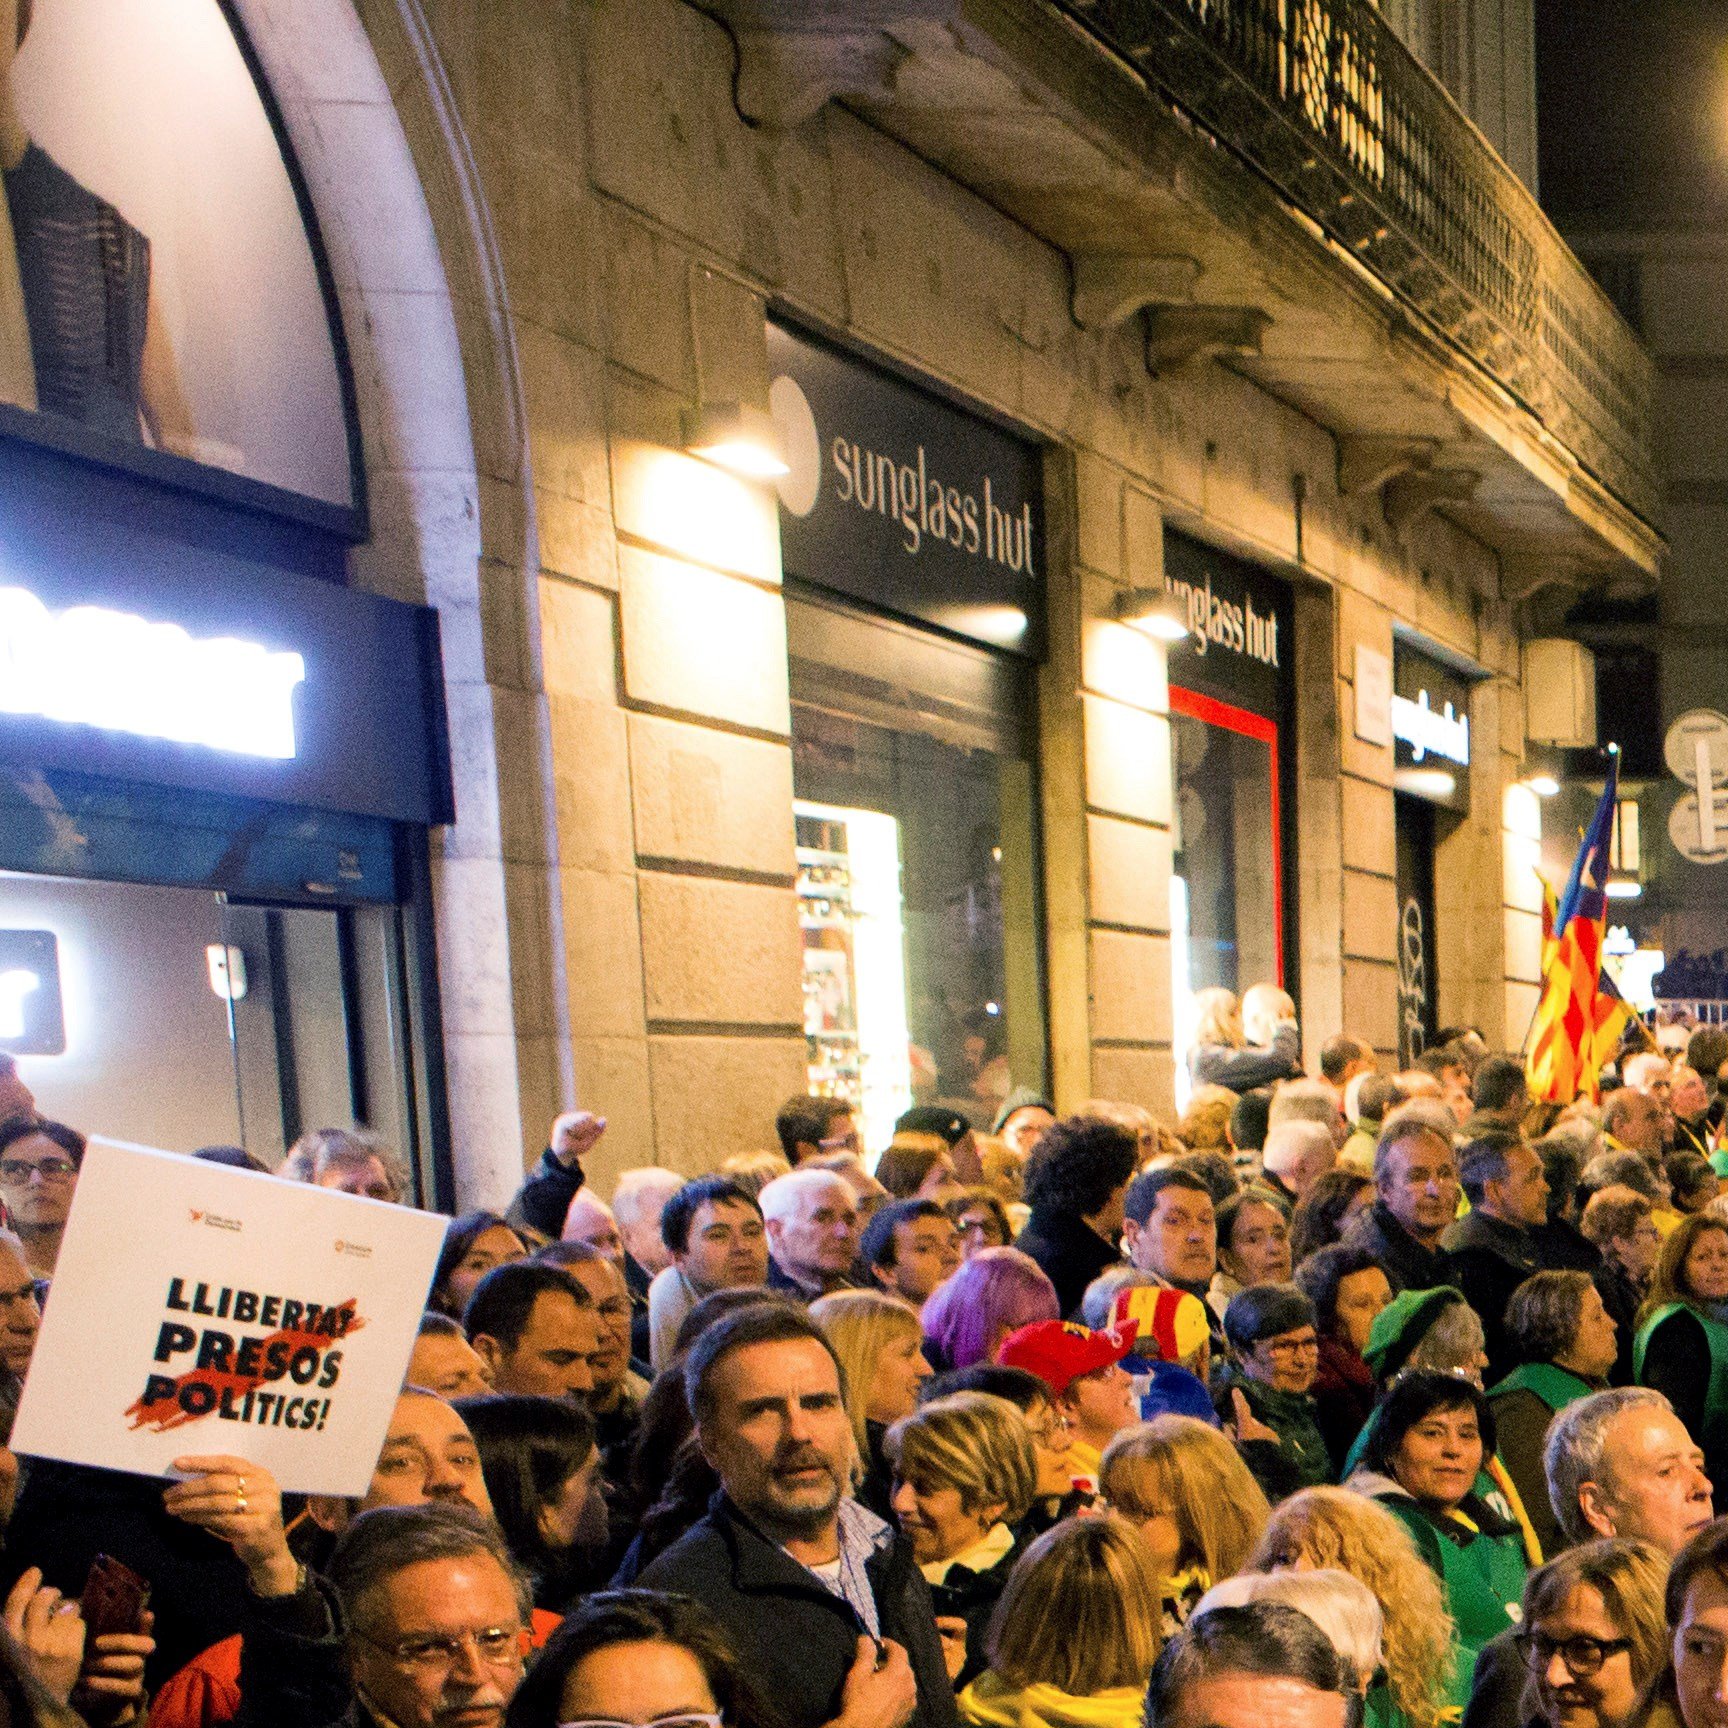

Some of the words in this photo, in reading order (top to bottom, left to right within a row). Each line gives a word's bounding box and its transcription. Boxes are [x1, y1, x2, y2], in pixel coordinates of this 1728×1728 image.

[833, 436, 980, 554] sunglass
[984, 475, 1035, 577] hut
[1245, 592, 1279, 668] hut
[166, 1276, 355, 1339] LLIBERTAT
[153, 1320, 344, 1389] PRESOS
